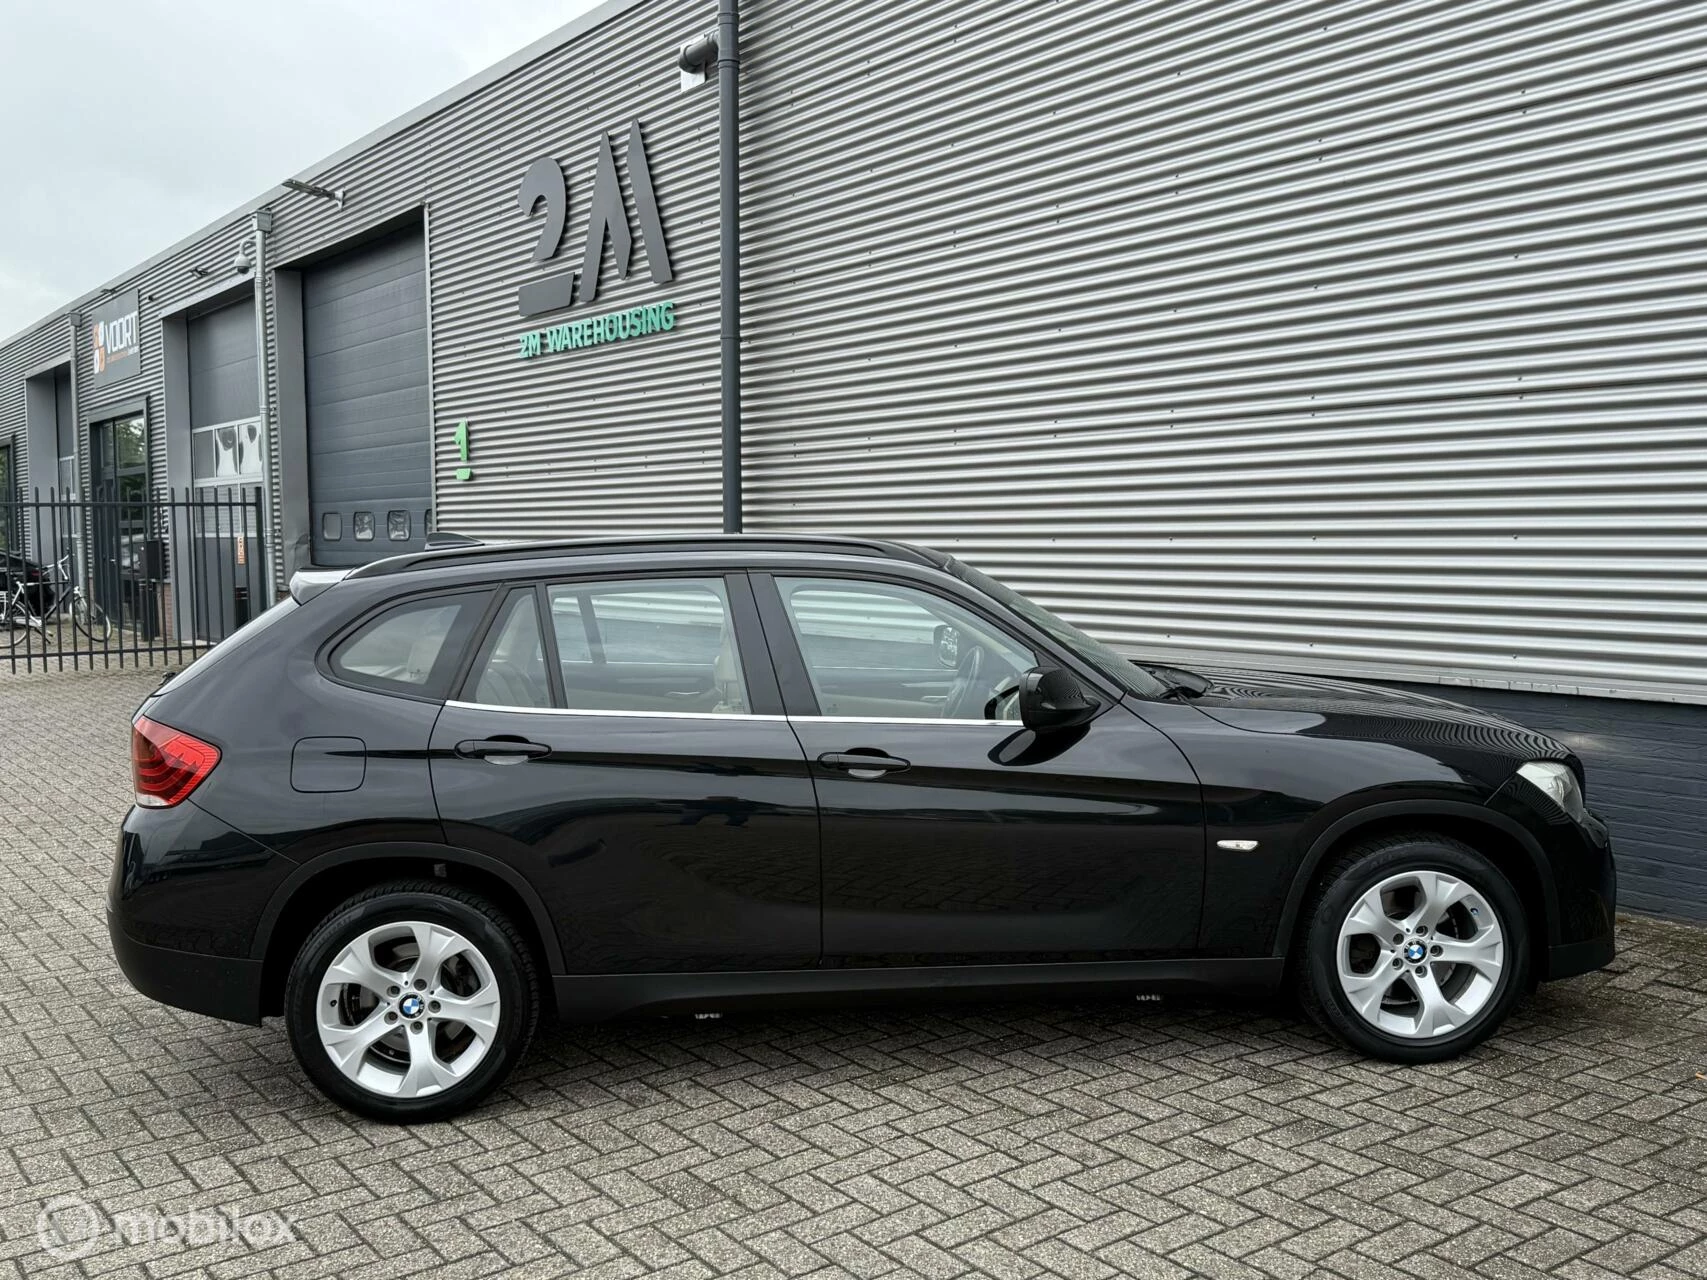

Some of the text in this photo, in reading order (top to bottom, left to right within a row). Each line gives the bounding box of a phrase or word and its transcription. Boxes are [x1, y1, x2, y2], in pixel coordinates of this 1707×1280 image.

[518, 118, 673, 316] 2M
[105, 310, 138, 354] VOORT
[519, 302, 675, 358] 2M WAREHOUSING
